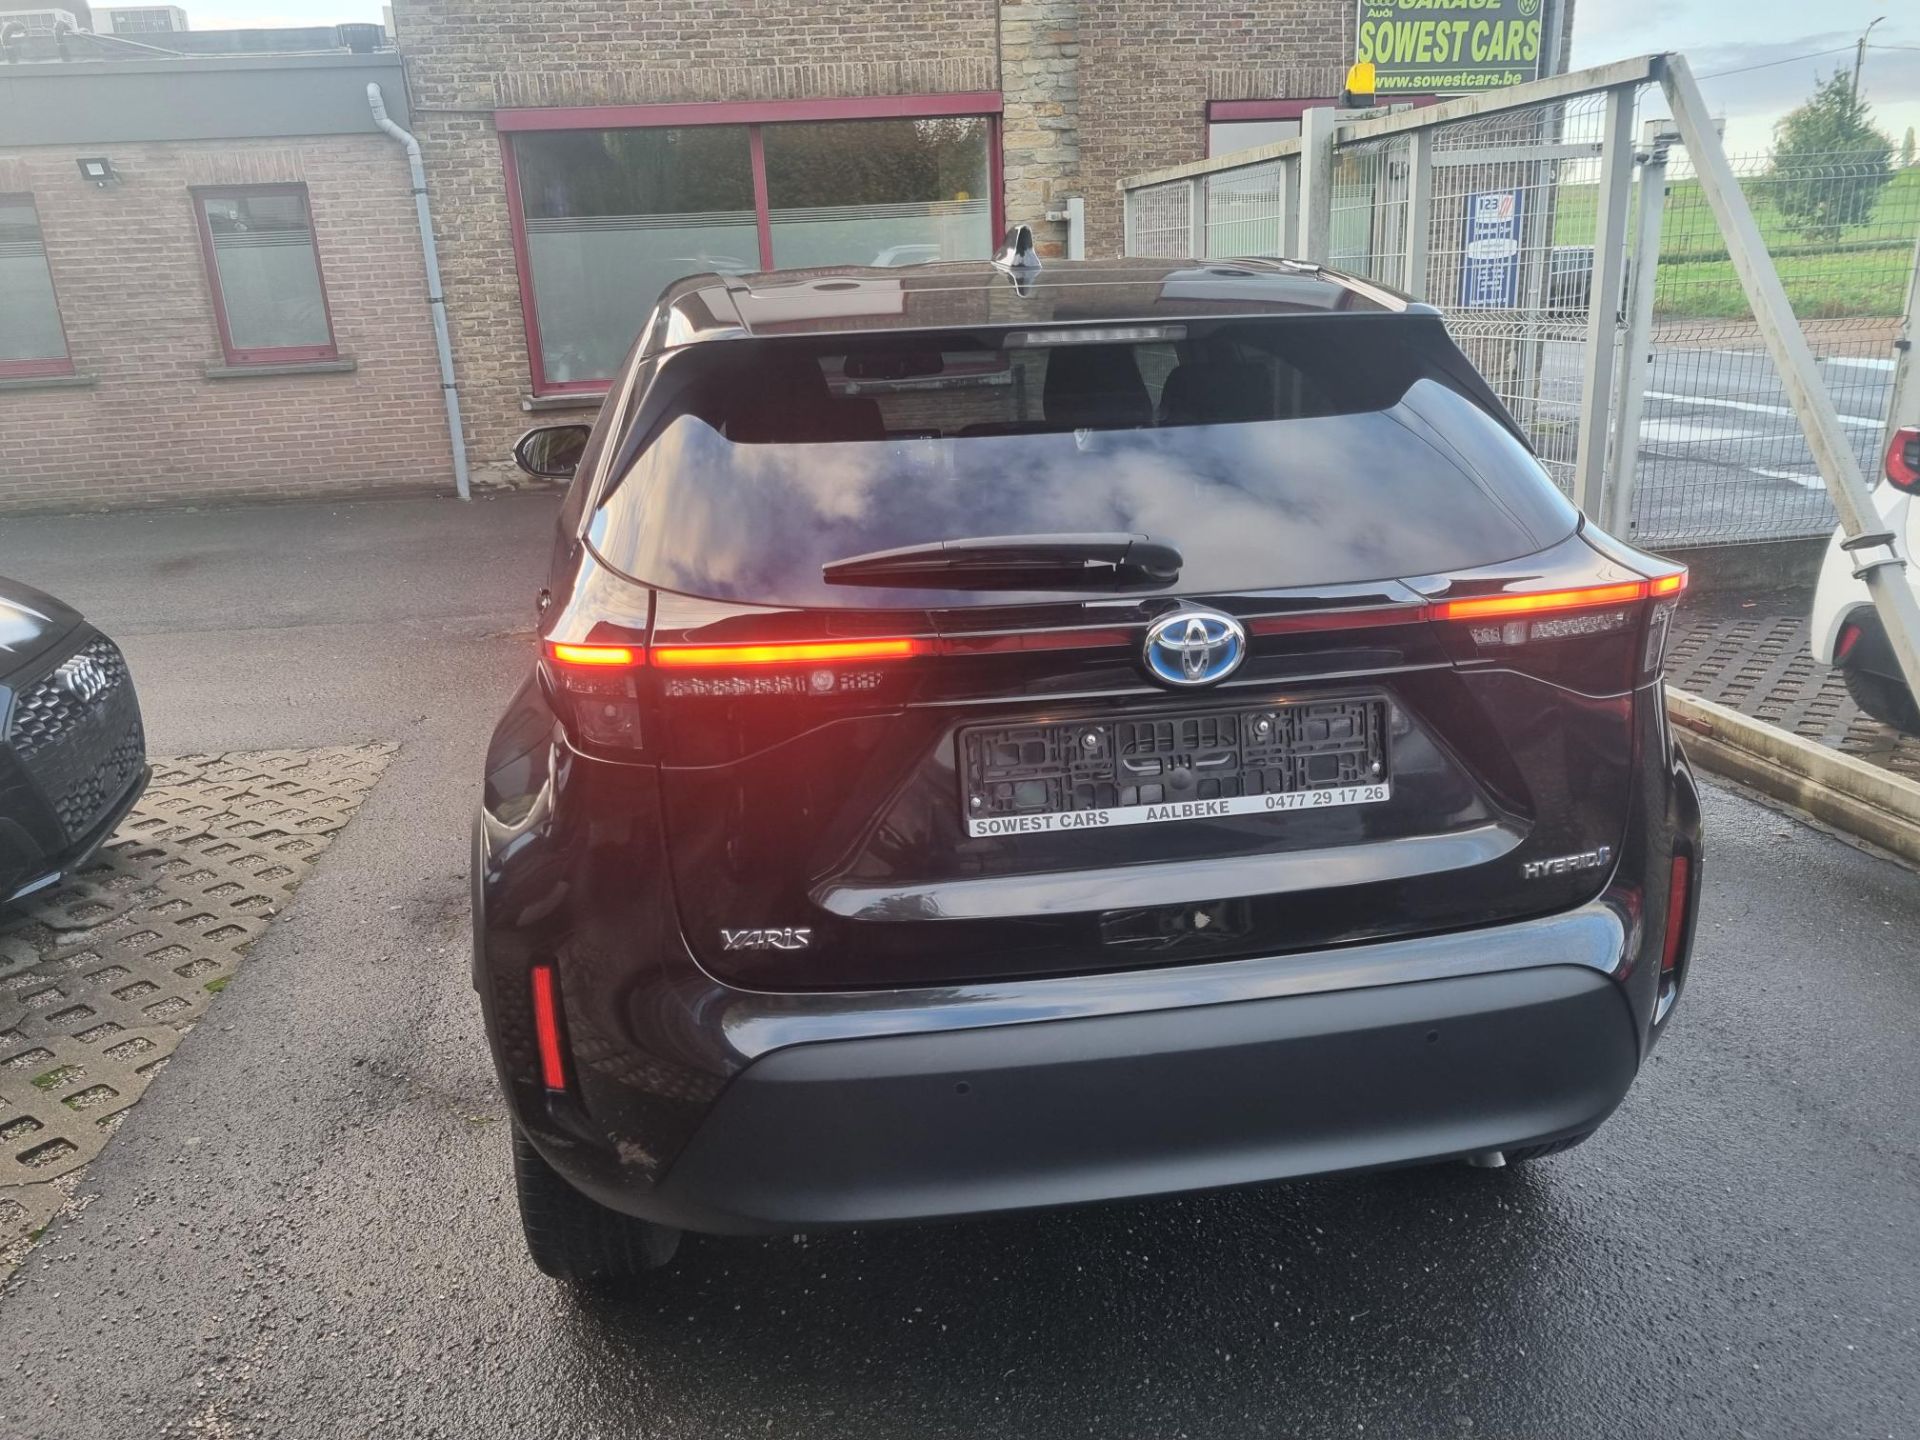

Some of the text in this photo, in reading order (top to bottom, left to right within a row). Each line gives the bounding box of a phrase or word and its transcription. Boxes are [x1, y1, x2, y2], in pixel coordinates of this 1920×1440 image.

[1366, 8, 1393, 18] Audi
[1359, 19, 1540, 64] SOWEST CARS
[1375, 71, 1521, 88] www.sowestcars.be
[976, 786, 1384, 835] SOWEST CARS AALBEKE 0477 29 17 26
